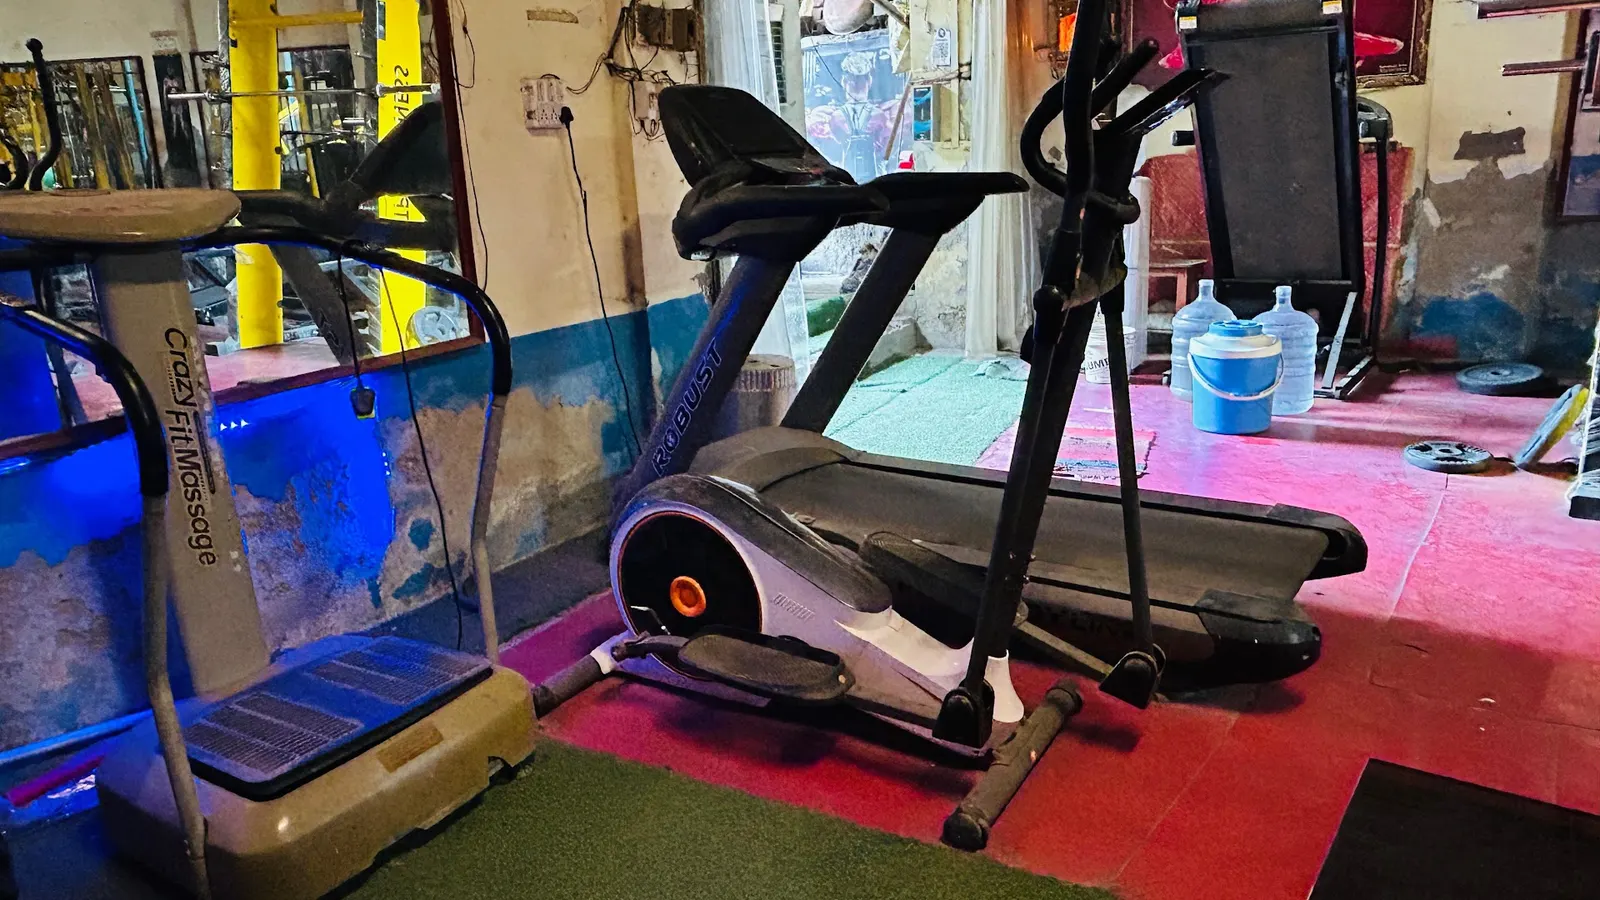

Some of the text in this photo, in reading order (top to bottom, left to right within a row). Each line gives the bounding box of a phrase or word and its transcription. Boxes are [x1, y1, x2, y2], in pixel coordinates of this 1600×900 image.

[164, 327, 217, 566] Crazy Fit Massage
[651, 336, 723, 477] ROBUST
